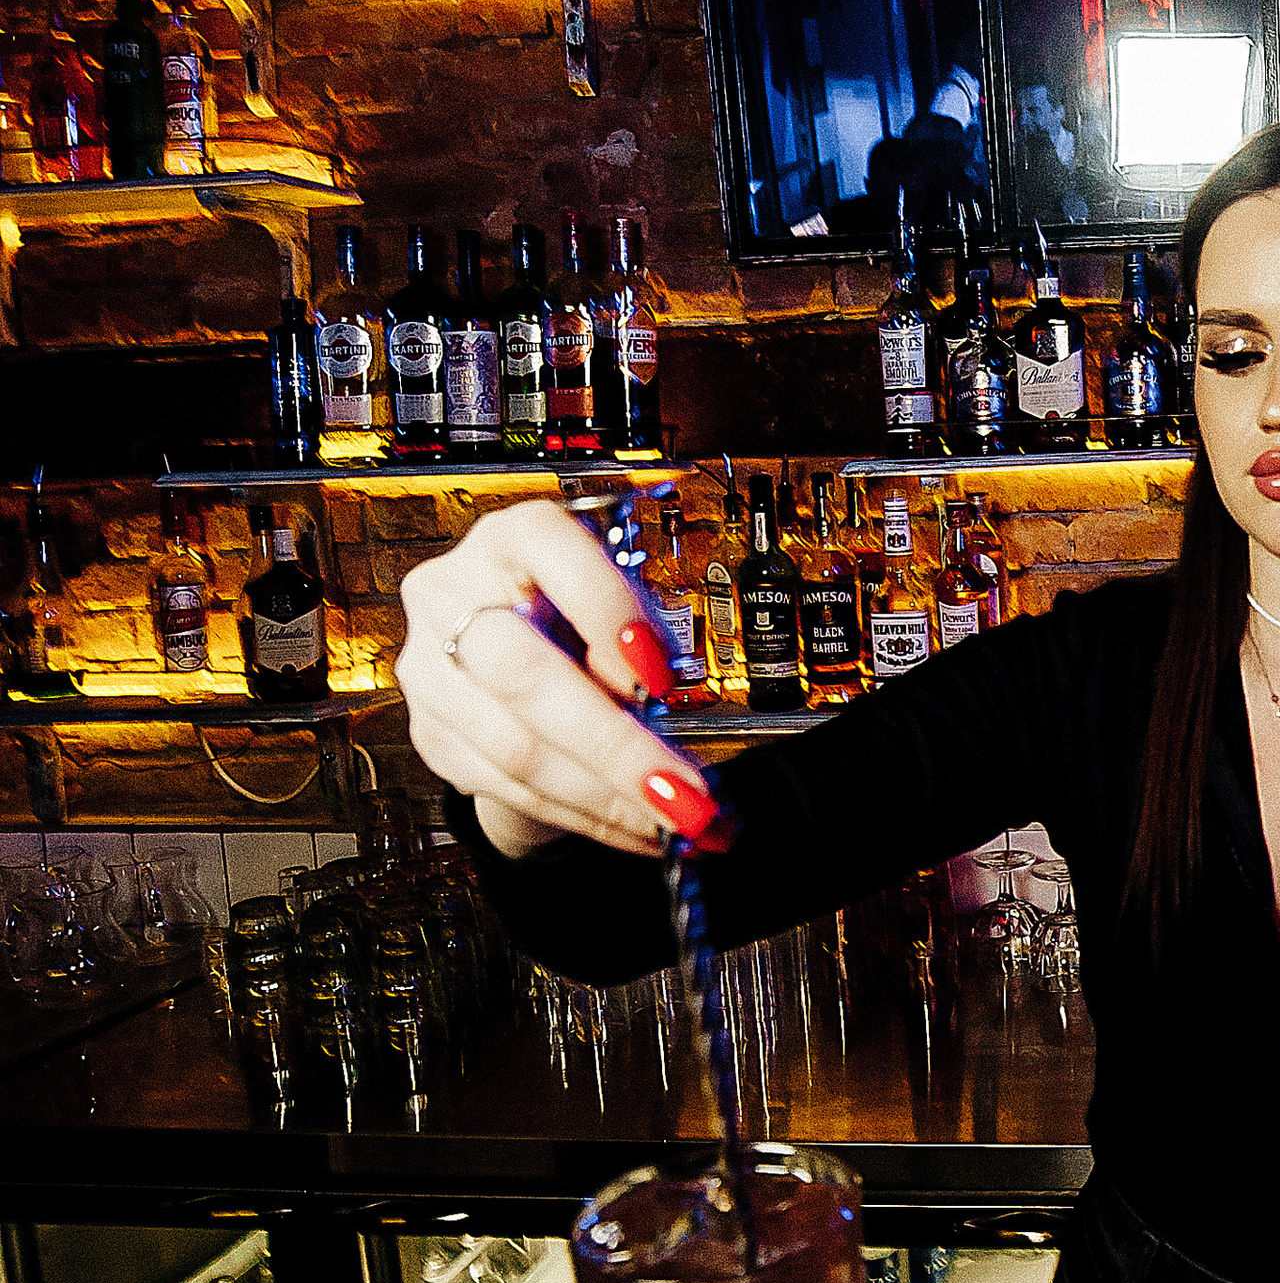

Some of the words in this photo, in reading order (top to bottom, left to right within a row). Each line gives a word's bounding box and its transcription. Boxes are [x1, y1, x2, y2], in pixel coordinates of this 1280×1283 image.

[547, 335, 589, 347] MARTINI
[321, 344, 367, 357] MARTINI
[802, 590, 853, 604] JAMESON
[941, 611, 977, 624] Dewar's
[812, 625, 846, 638] BLACK
[812, 641, 850, 654] BARREL
